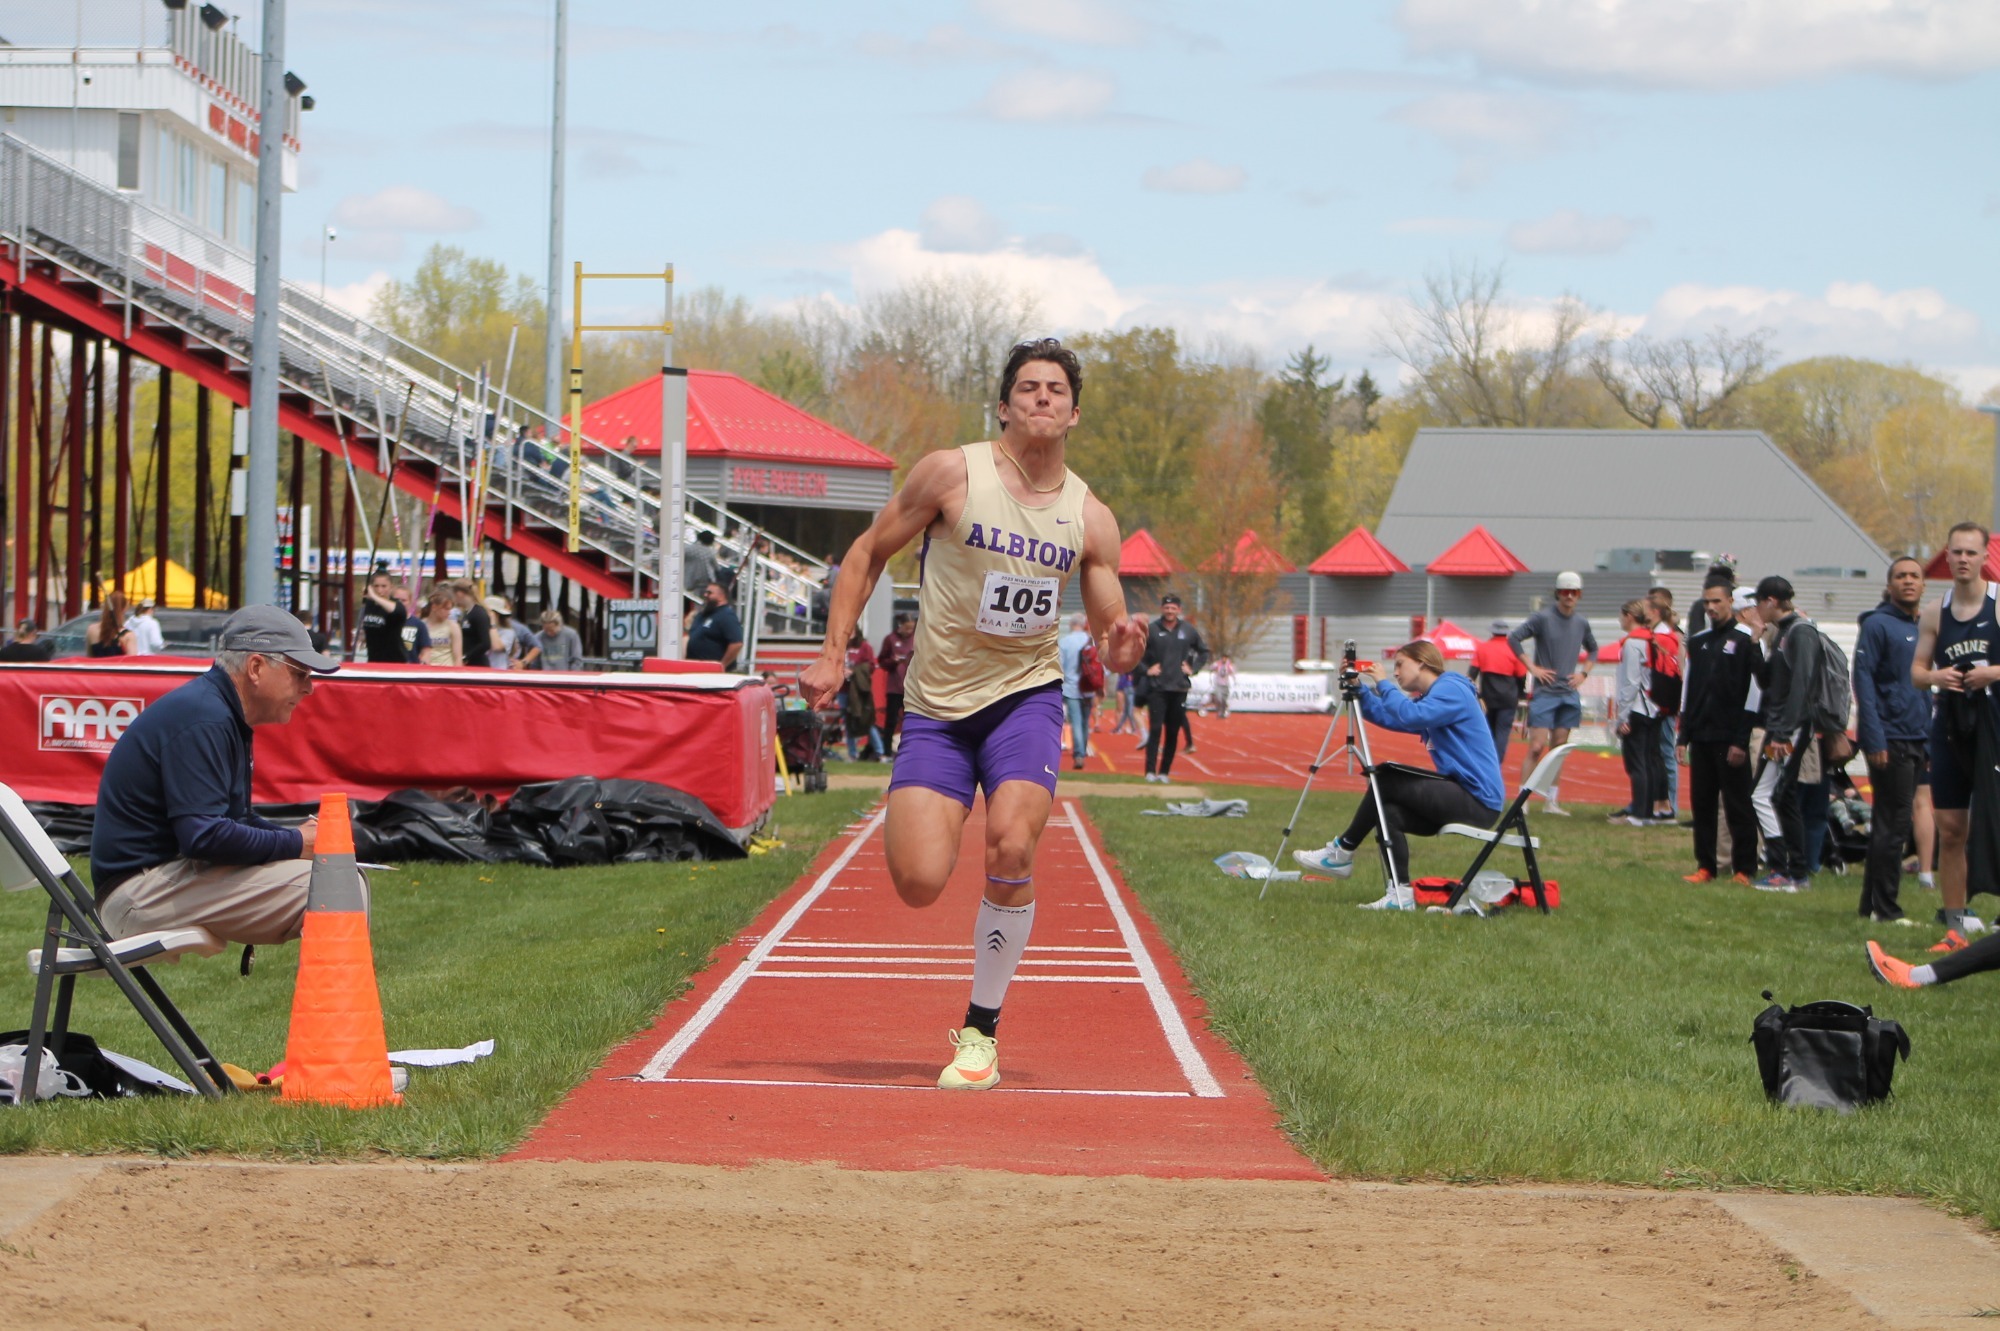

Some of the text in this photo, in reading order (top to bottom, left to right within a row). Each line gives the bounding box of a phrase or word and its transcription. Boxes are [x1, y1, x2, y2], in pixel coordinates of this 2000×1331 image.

[965, 523, 1076, 573] ALBION
[990, 585, 1053, 617] 105
[1944, 639, 1990, 660] TRINE
[1232, 690, 1320, 702] AMPIONSHIP
